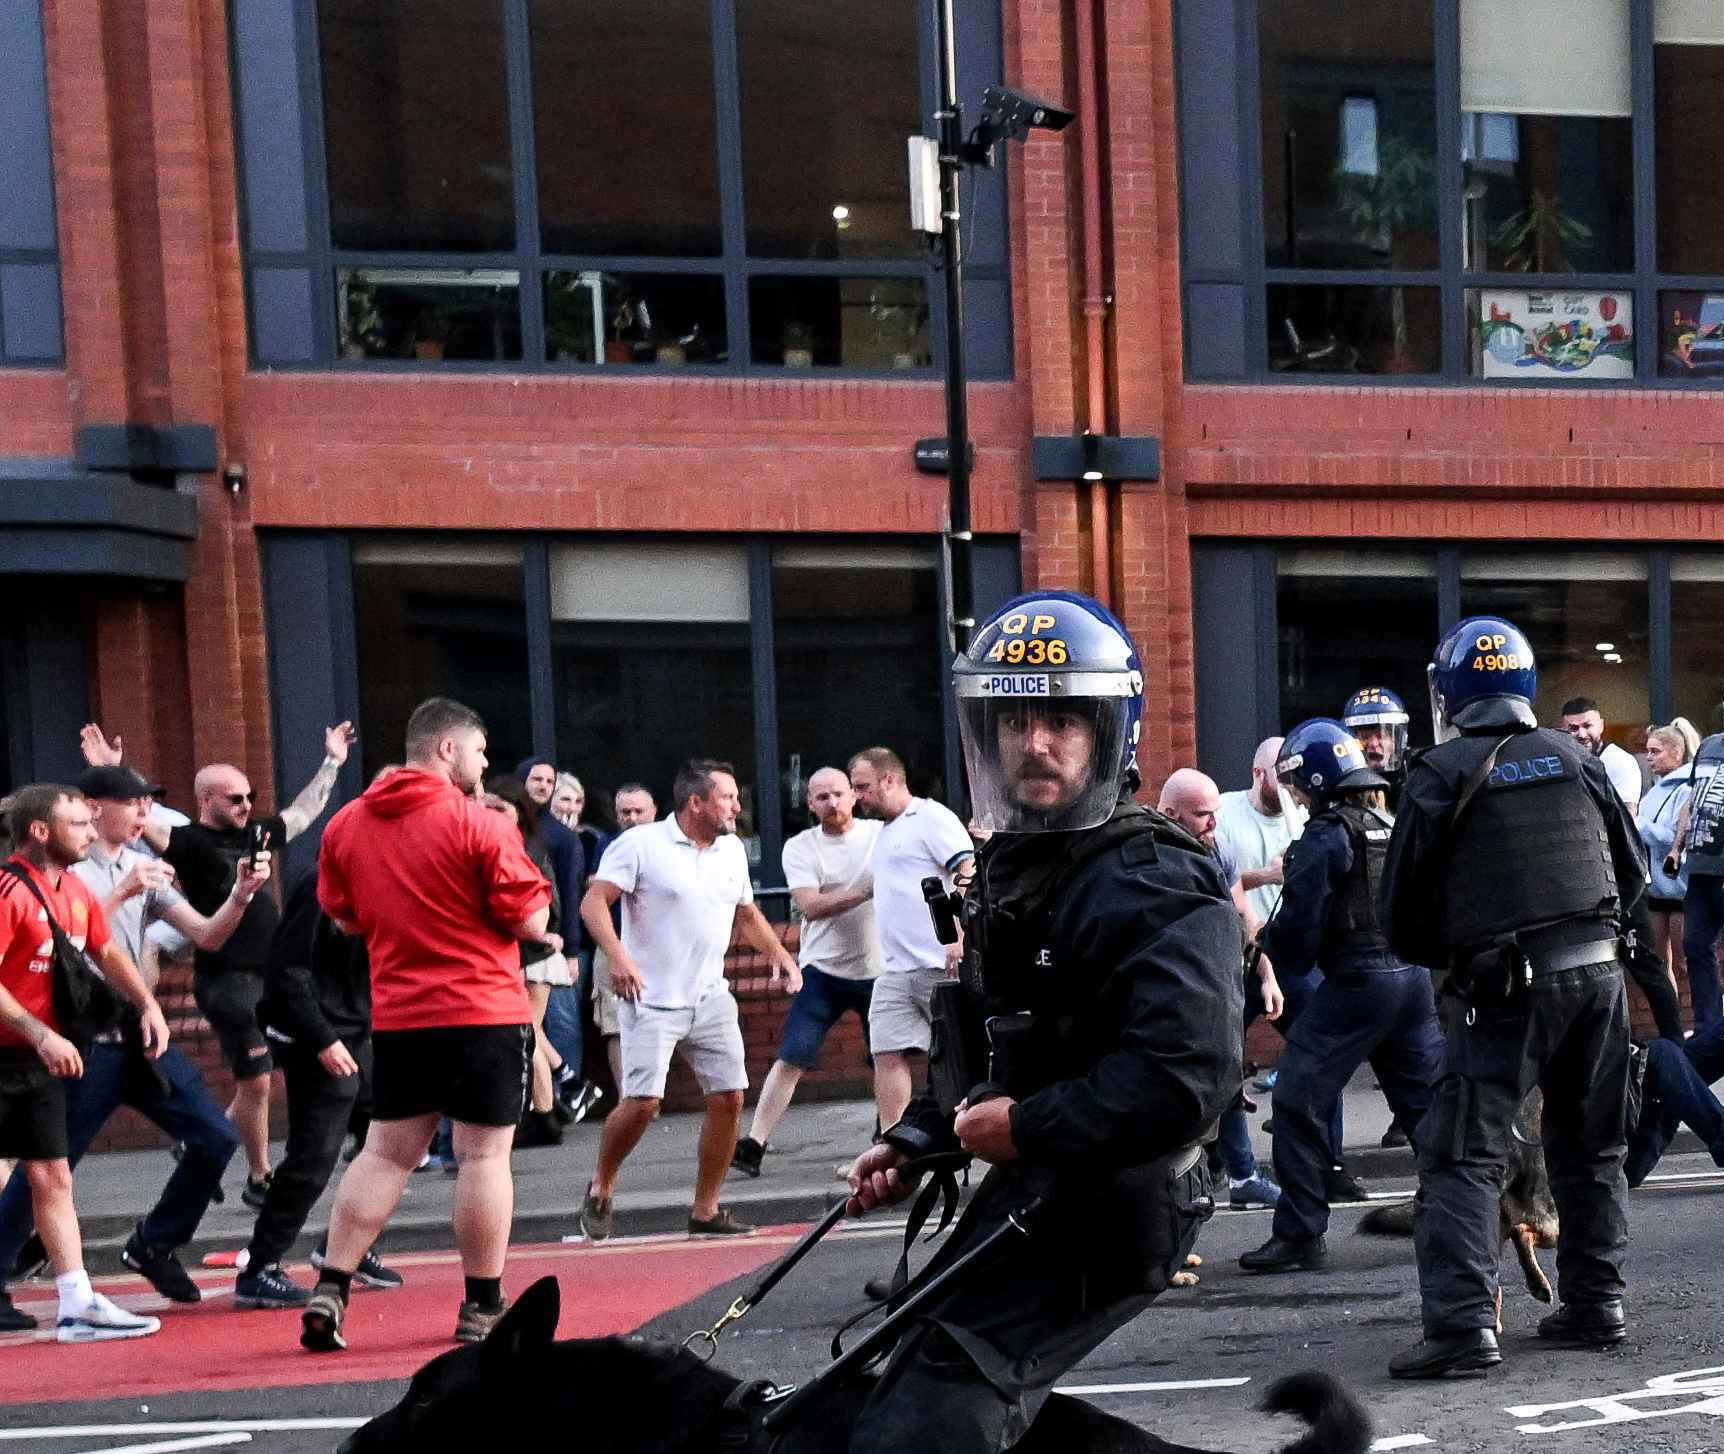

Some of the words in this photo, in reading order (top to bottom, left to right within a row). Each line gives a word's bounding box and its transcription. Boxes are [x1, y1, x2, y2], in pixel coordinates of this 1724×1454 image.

[1002, 614, 1056, 635] QP
[988, 639, 1068, 664] 4936
[1476, 634, 1506, 652] QP
[1473, 654, 1519, 671] 4908
[991, 677, 1046, 694] POLICE
[1488, 756, 1563, 784] POLICE
